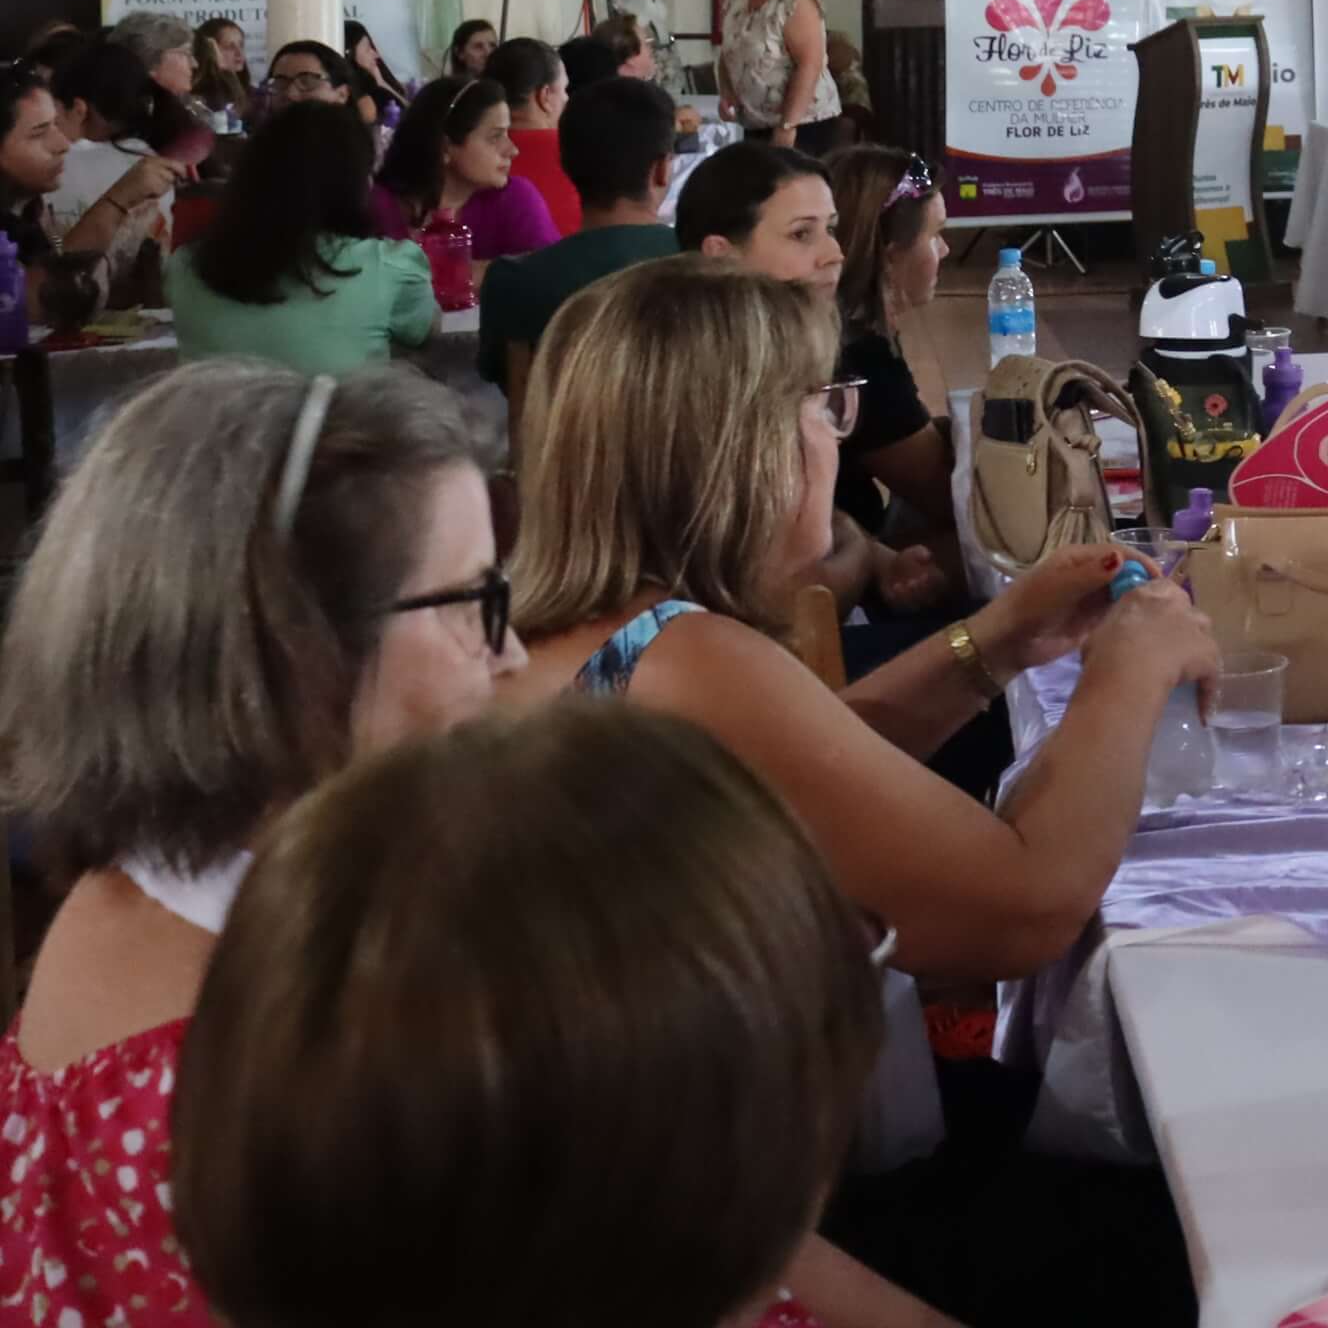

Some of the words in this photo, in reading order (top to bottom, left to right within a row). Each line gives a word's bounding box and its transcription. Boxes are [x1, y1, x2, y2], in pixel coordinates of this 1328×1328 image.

[973, 33, 1036, 63] Flor
[1060, 33, 1109, 64] Liz
[1211, 63, 1245, 89] TM
[967, 98, 1024, 114] CENTRO
[1027, 98, 1044, 113] DE
[1218, 98, 1231, 109] de
[1009, 111, 1029, 125] DA
[1005, 126, 1042, 139] FLOR
[1047, 126, 1065, 138] DE
[1070, 124, 1091, 137] LIZ
